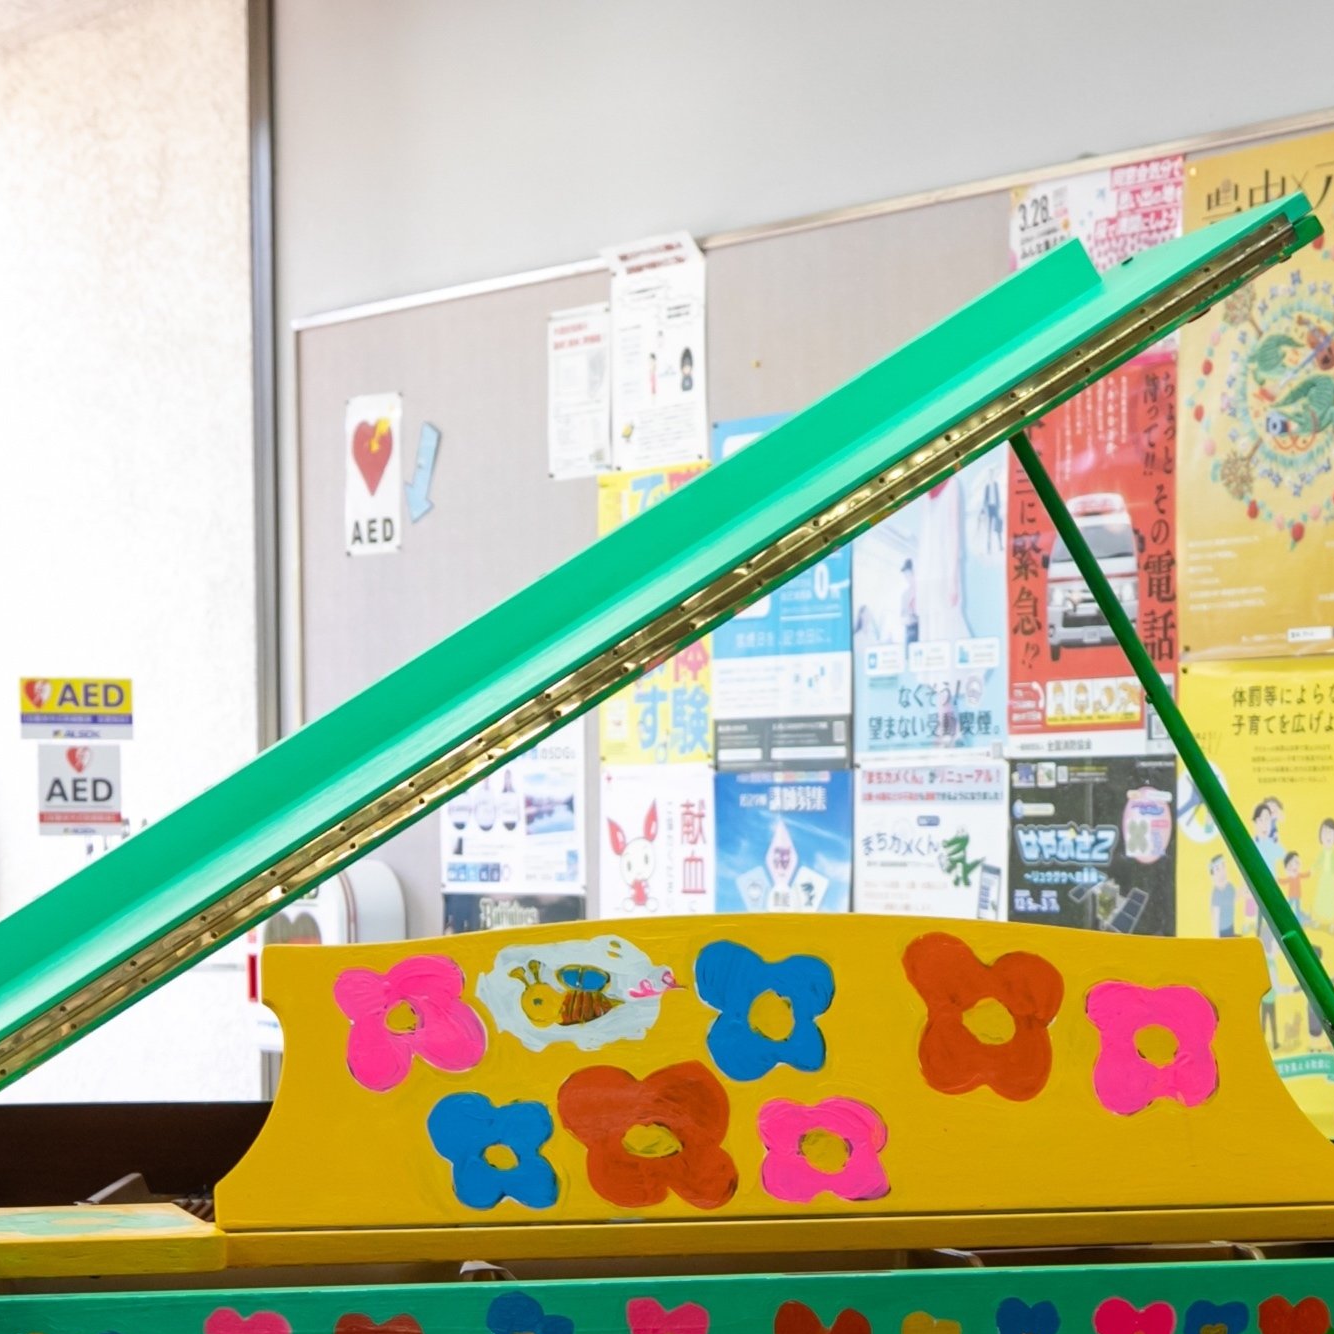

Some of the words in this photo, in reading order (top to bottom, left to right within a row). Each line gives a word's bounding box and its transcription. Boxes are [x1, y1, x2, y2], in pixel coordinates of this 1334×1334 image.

[1163, 371, 1176, 475] ちょっと
[351, 517, 395, 546] AED
[1143, 484, 1177, 661] その電話
[58, 683, 125, 708] AED
[869, 710, 1001, 741] 望まない受動喫煙。
[46, 777, 114, 803] AED
[862, 832, 940, 857] まちカメくん
